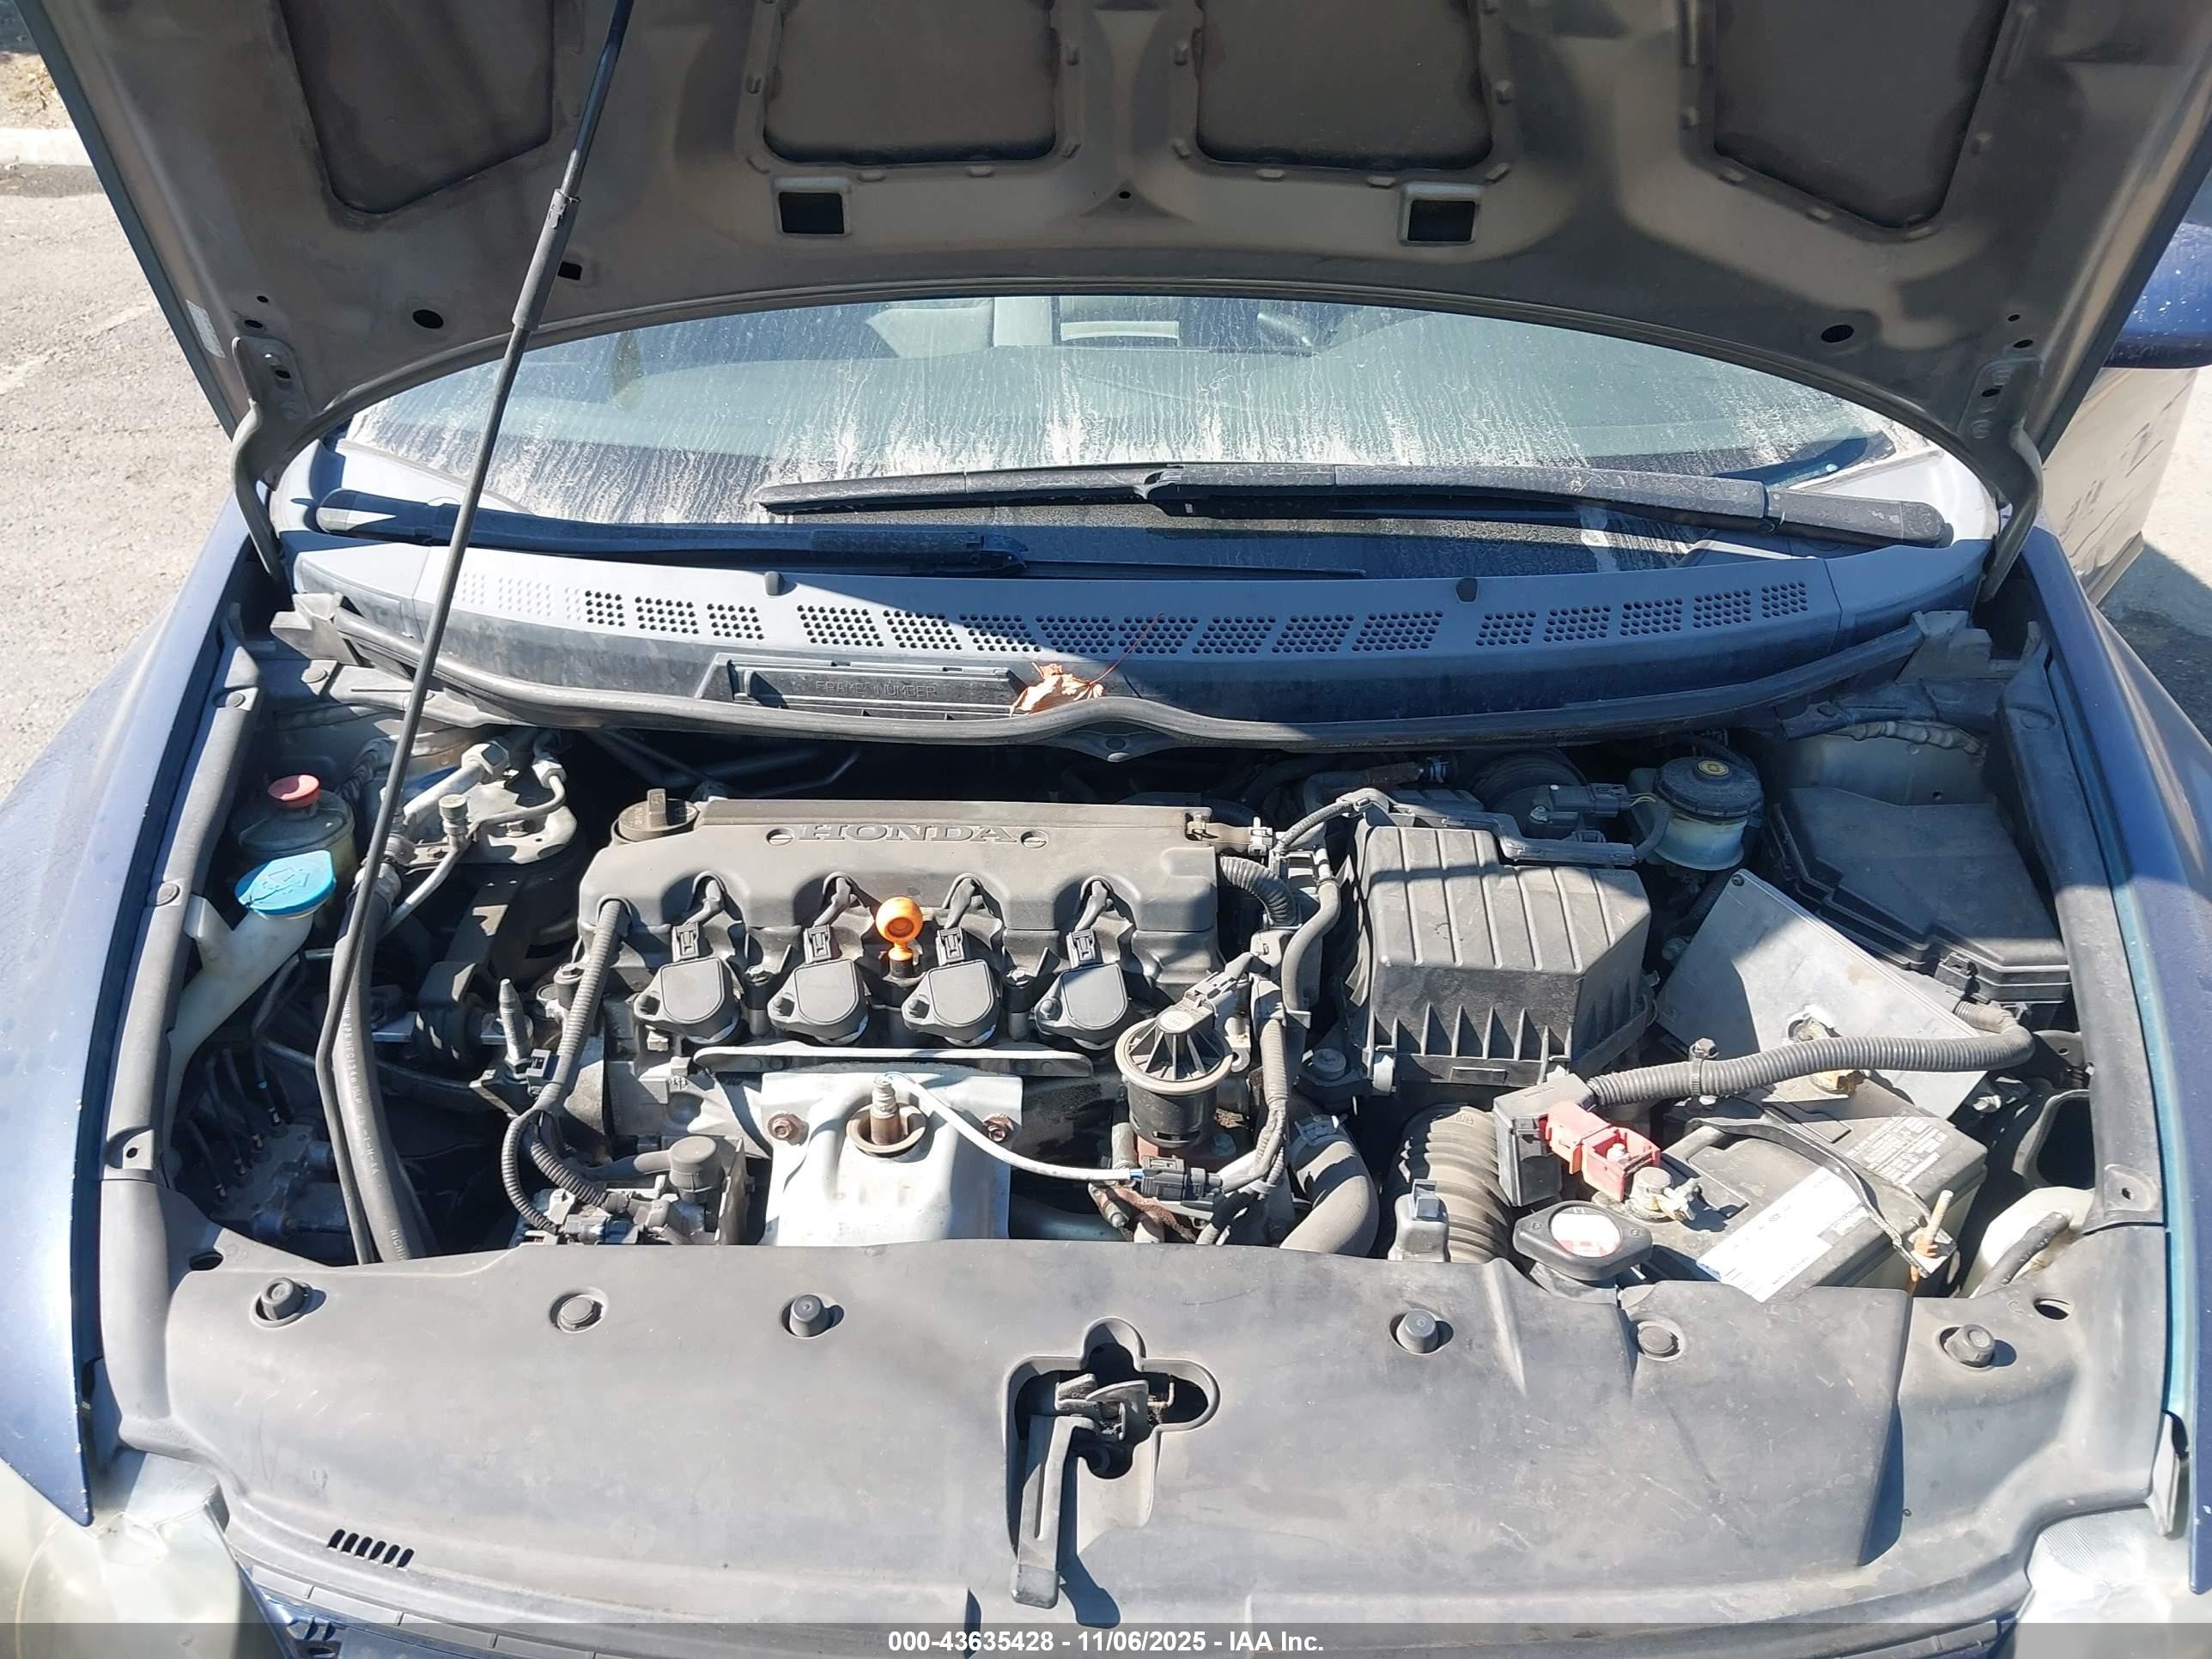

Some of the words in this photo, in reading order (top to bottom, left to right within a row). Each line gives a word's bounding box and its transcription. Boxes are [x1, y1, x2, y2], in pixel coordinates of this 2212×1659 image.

[816, 680, 868, 694] FRAME
[874, 684, 937, 697] NUMBER
[799, 823, 1017, 843] HONDA
